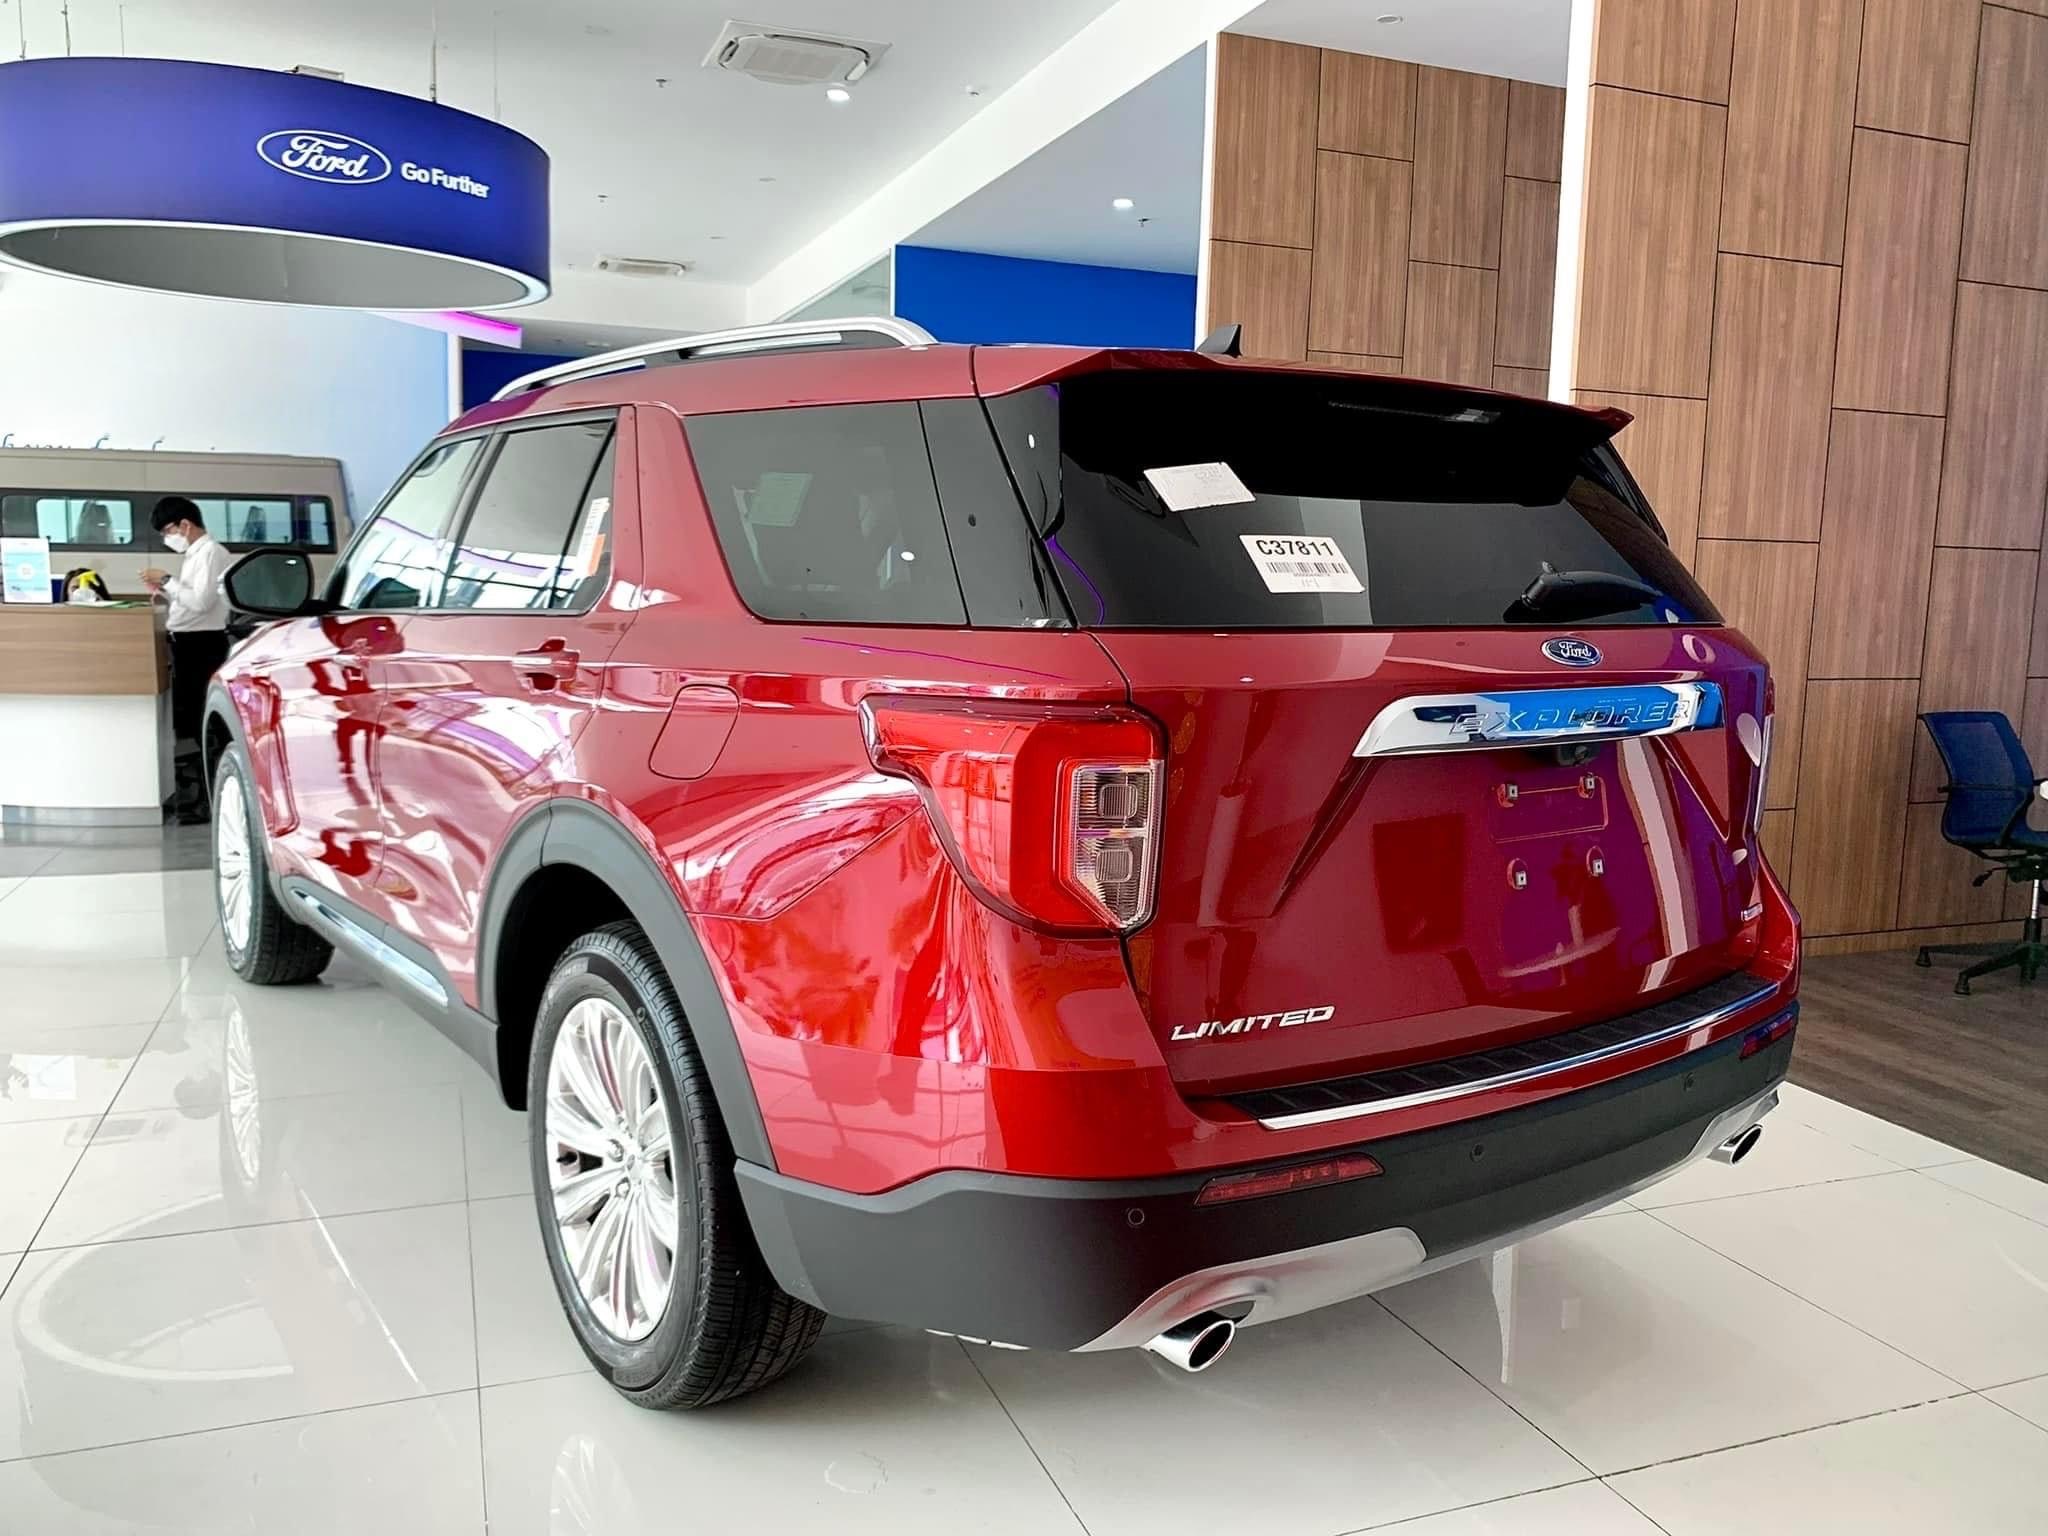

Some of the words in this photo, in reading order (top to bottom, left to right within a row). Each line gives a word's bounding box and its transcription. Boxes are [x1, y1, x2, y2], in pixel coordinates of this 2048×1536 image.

[281, 135, 370, 178] Ford
[401, 162, 430, 184] Go
[431, 168, 490, 198] Further
[1255, 539, 1334, 556] C37811
[1559, 641, 1591, 658] Ford
[1449, 700, 1690, 735] EXPLORER
[1171, 1005, 1336, 1041] LIMITED
